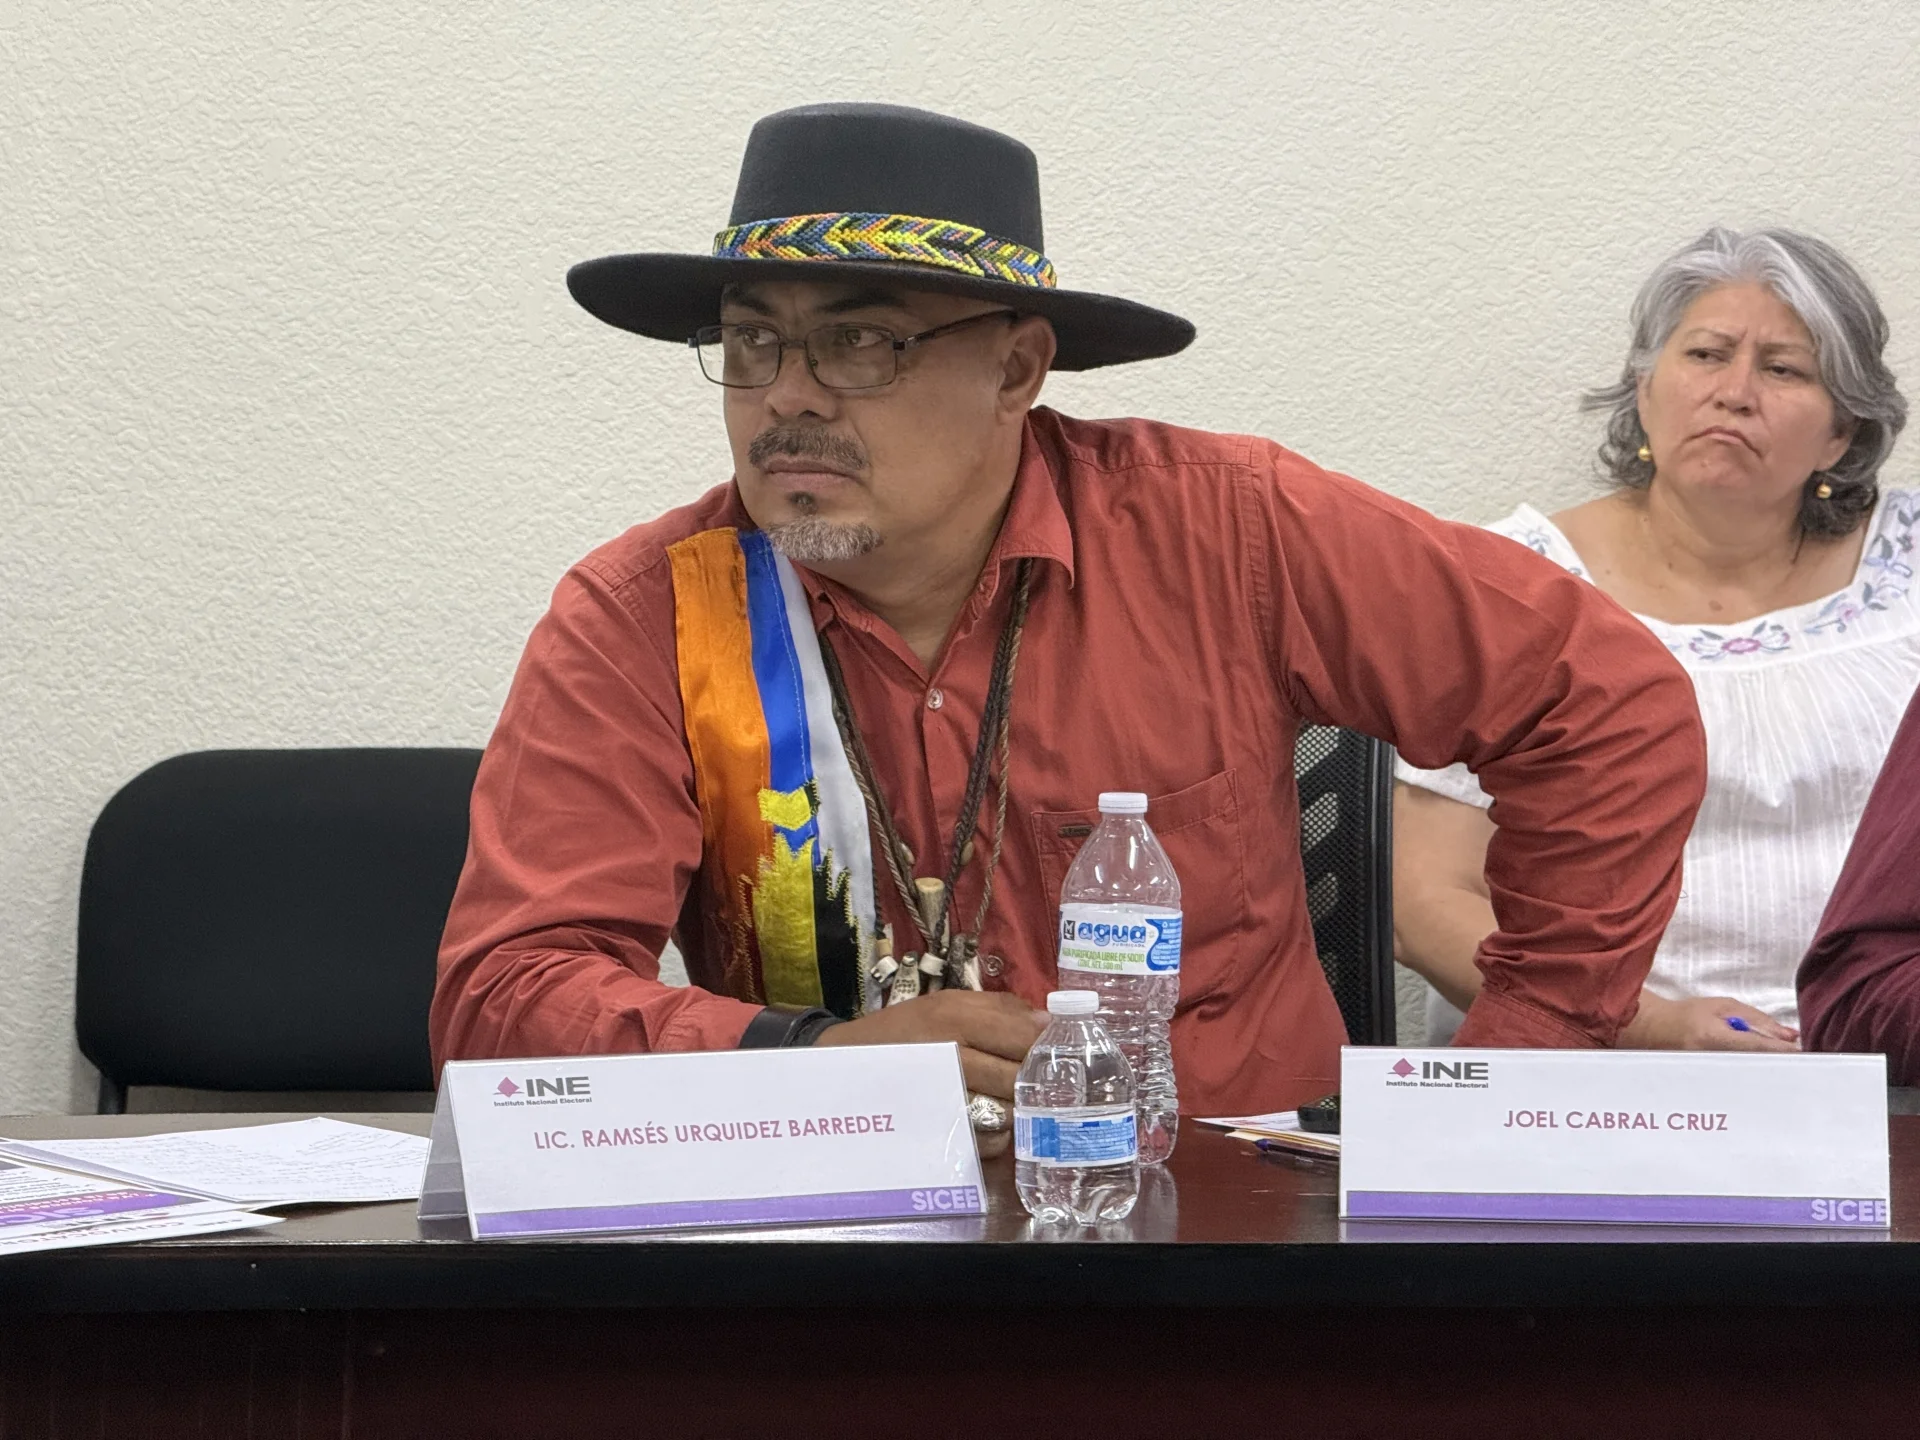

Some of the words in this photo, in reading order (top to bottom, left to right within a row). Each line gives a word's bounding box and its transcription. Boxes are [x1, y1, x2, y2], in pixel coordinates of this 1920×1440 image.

[1078, 922, 1146, 947] agua
[1072, 949, 1101, 959] PURIFICADA
[1101, 951, 1118, 961] LIBRE
[1119, 952, 1127, 962] DE
[1422, 1061, 1489, 1080] INE
[525, 1076, 591, 1097] INE
[494, 1099, 525, 1107] Instituto
[526, 1098, 558, 1106] Nacional
[1503, 1110, 1559, 1128] JOEL
[1565, 1111, 1660, 1130] CABRAL
[1666, 1112, 1728, 1131] CRUZ
[534, 1130, 575, 1149] LIC.
[582, 1121, 669, 1148] RAMSÉS
[674, 1120, 783, 1143] URQUIDEZ
[788, 1114, 895, 1138] BARREDEZ
[911, 1188, 980, 1211] SICEE
[1811, 1198, 1887, 1222] SICEE
